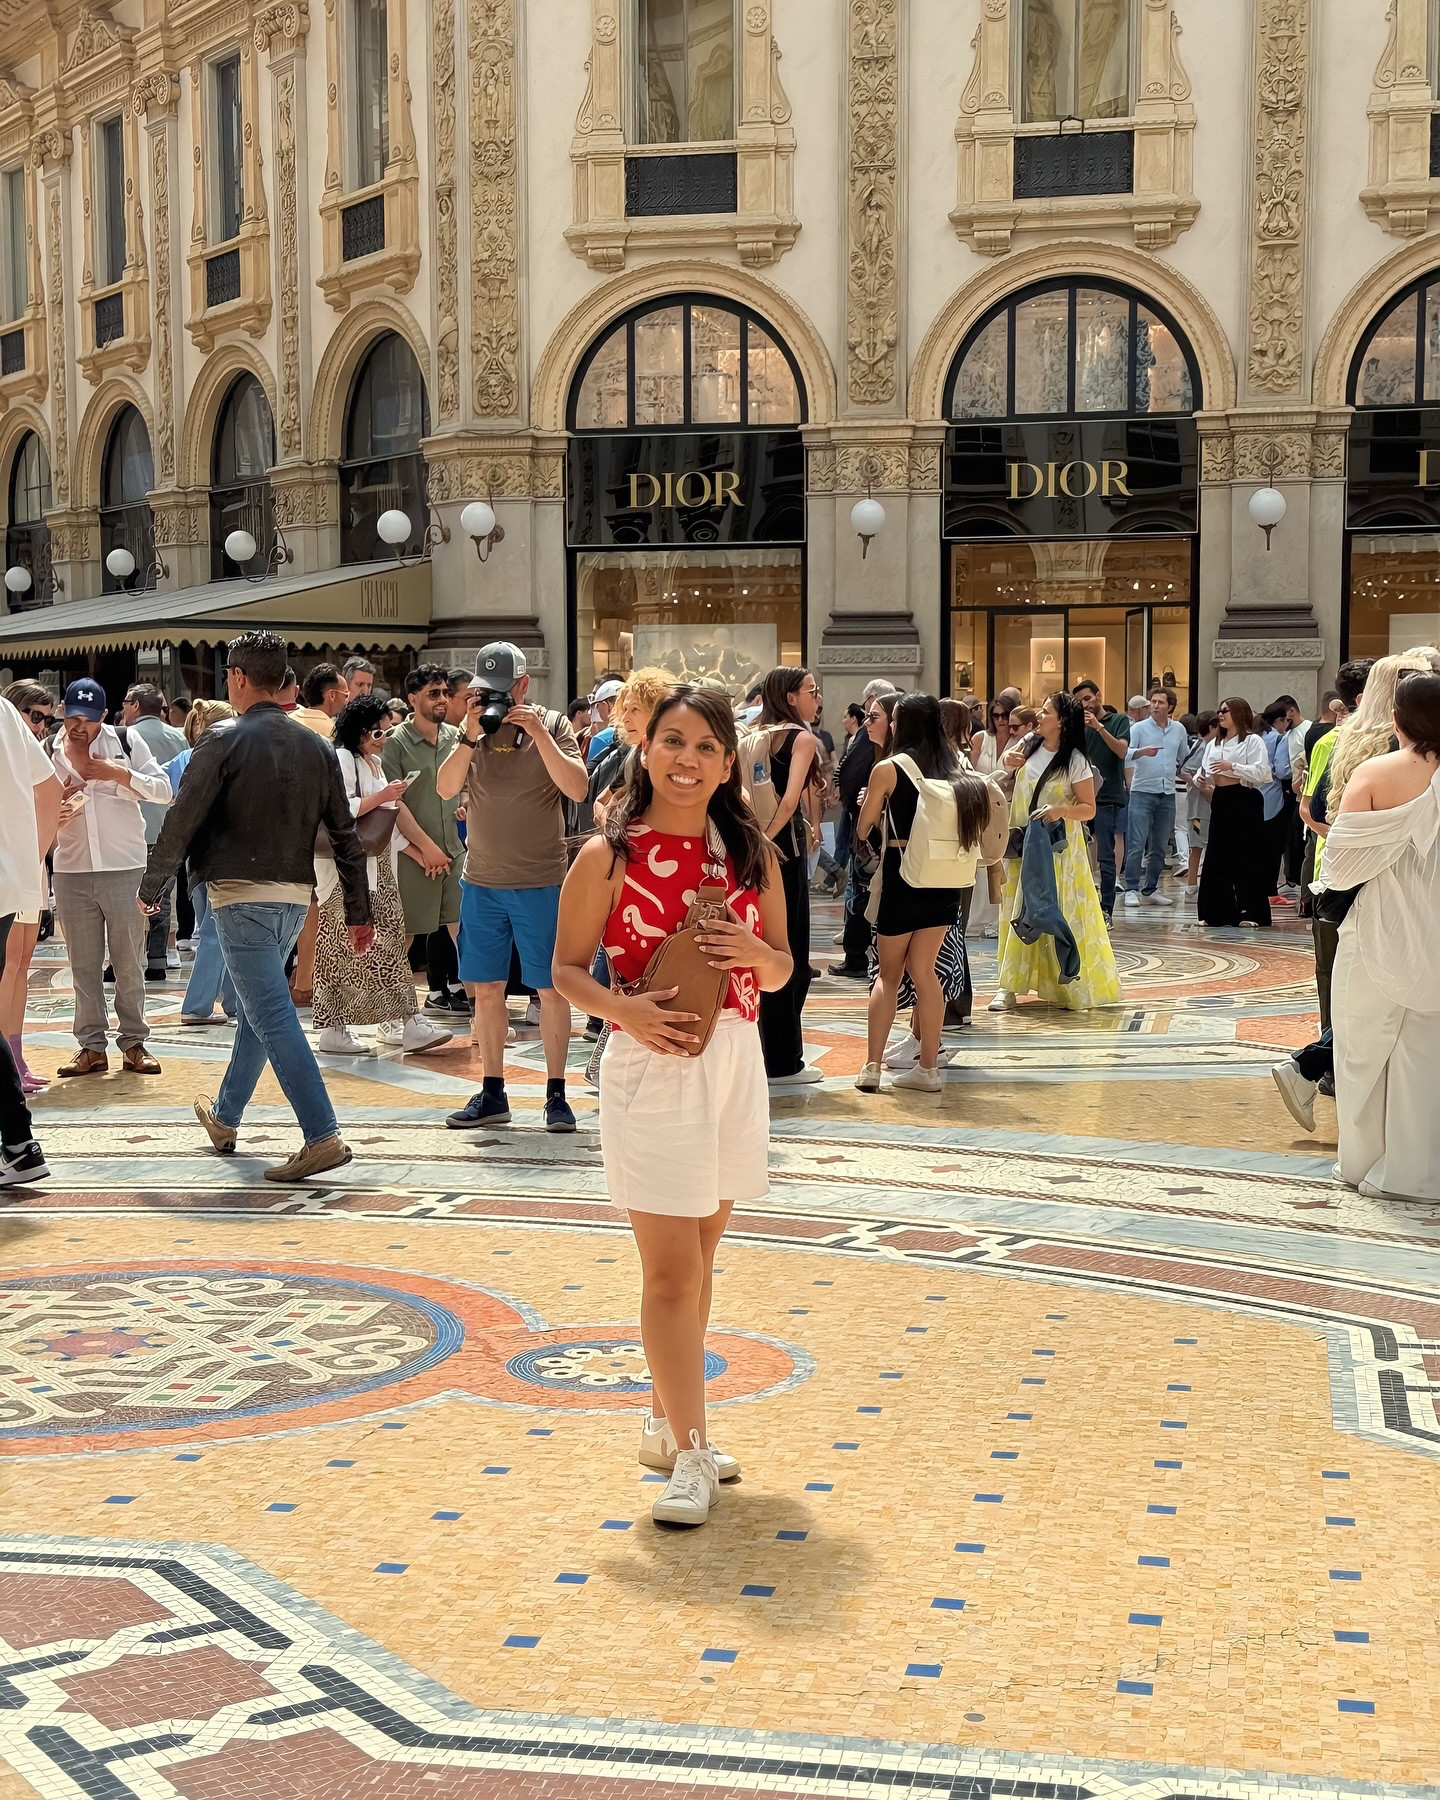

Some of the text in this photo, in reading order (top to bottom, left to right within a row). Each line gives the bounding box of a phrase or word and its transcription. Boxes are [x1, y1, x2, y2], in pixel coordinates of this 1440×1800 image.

[626, 471, 745, 508] DIOR
[1006, 460, 1134, 499] DIOR
[361, 580, 398, 618] CRACCO
